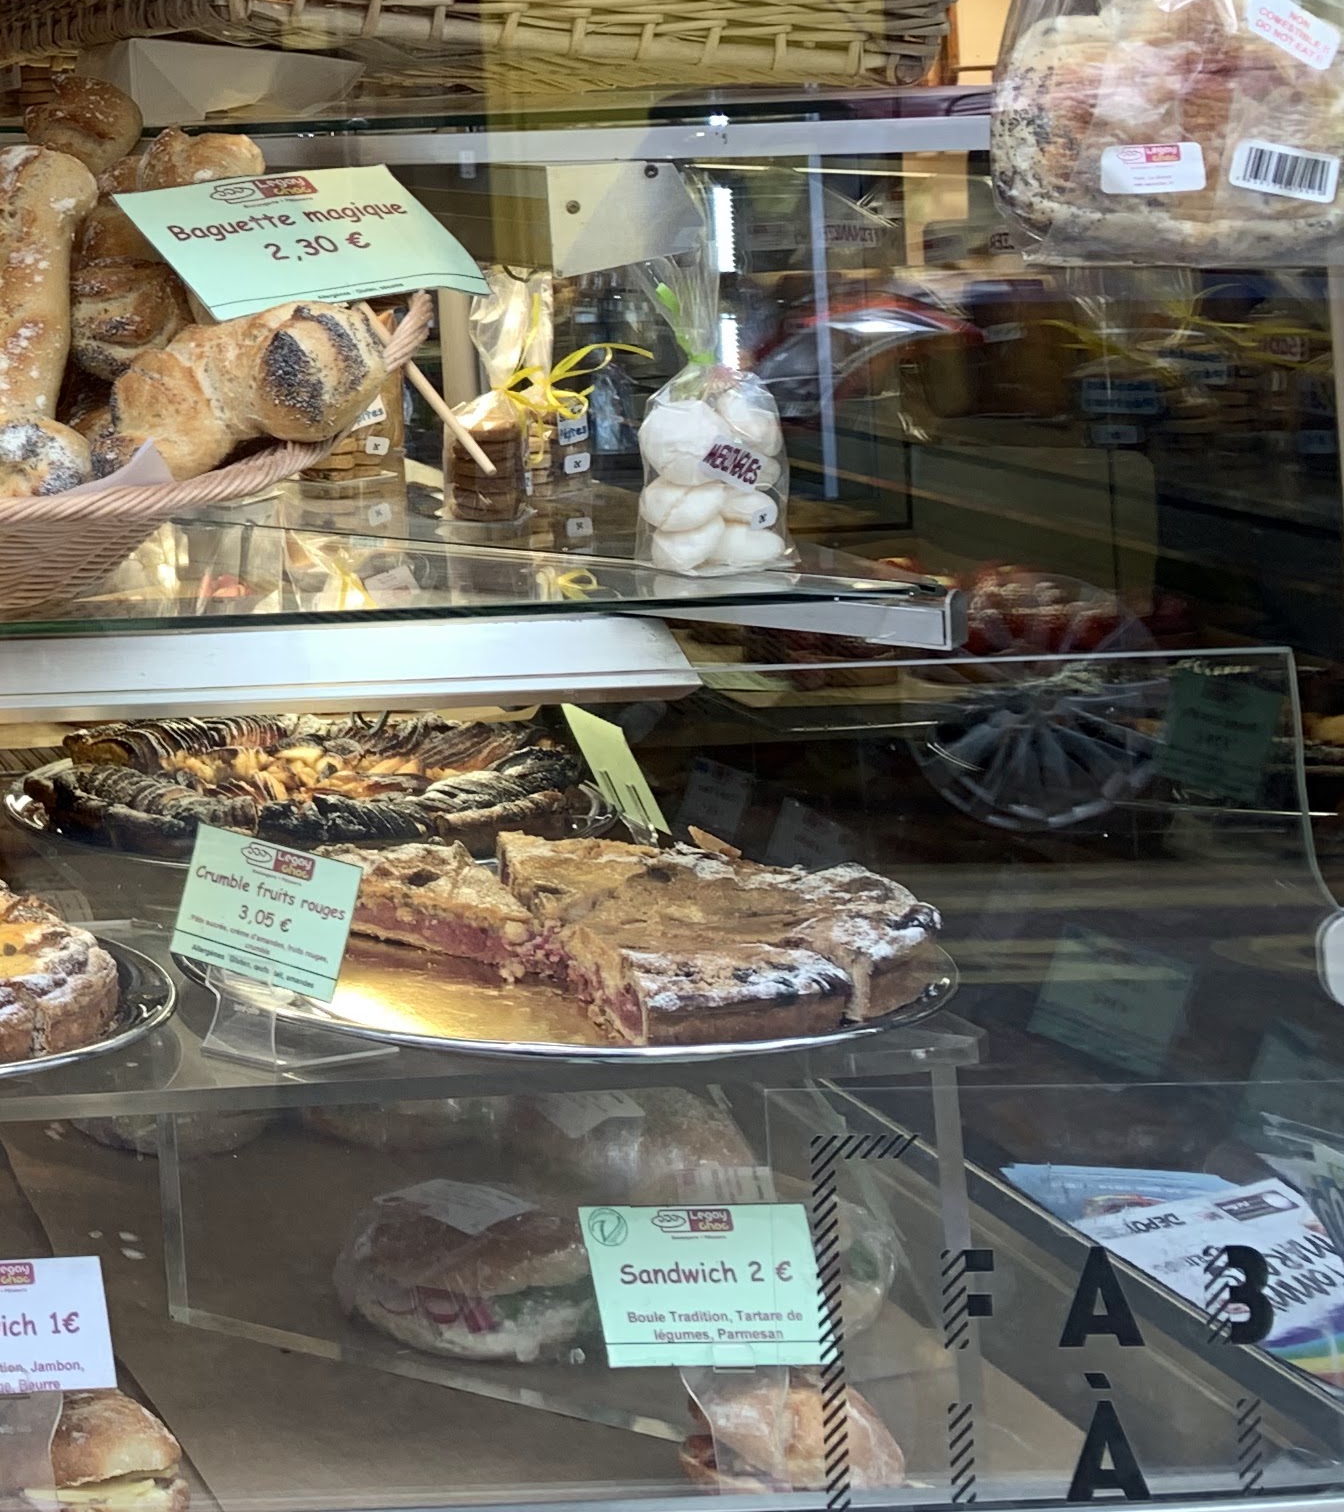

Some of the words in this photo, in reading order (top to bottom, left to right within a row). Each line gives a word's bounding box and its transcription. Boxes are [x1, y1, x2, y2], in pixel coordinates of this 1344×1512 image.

[256, 177, 306, 193] Legay
[273, 186, 313, 197] choc
[167, 213, 296, 241] Baguette
[303, 201, 408, 224] magique
[264, 235, 339, 261] 2,30
[345, 231, 371, 249] €
[276, 851, 313, 871] Legay
[281, 864, 310, 880] choc
[196, 865, 251, 893] Crumble
[256, 882, 295, 906] fruits
[300, 900, 346, 921] rouges
[238, 905, 275, 928] 3,05
[279, 918, 293, 933] €
[689, 1210, 728, 1222] Legay
[698, 1220, 730, 1231] choc
[0, 1274, 32, 1285] choc
[620, 1261, 738, 1286] Sandwich
[748, 1261, 765, 1282] 2
[775, 1261, 794, 1282] €
[49, 1311, 81, 1335] 1€
[627, 1311, 665, 1323] Boule
[670, 1310, 733, 1324] Tradition,
[735, 1310, 783, 1322] Tartare
[787, 1309, 803, 1321] de
[654, 1329, 714, 1343] légumes,
[717, 1327, 784, 1340] Parmesan
[30, 1360, 85, 1373] Jambon,
[19, 1379, 61, 1392] Beurre
